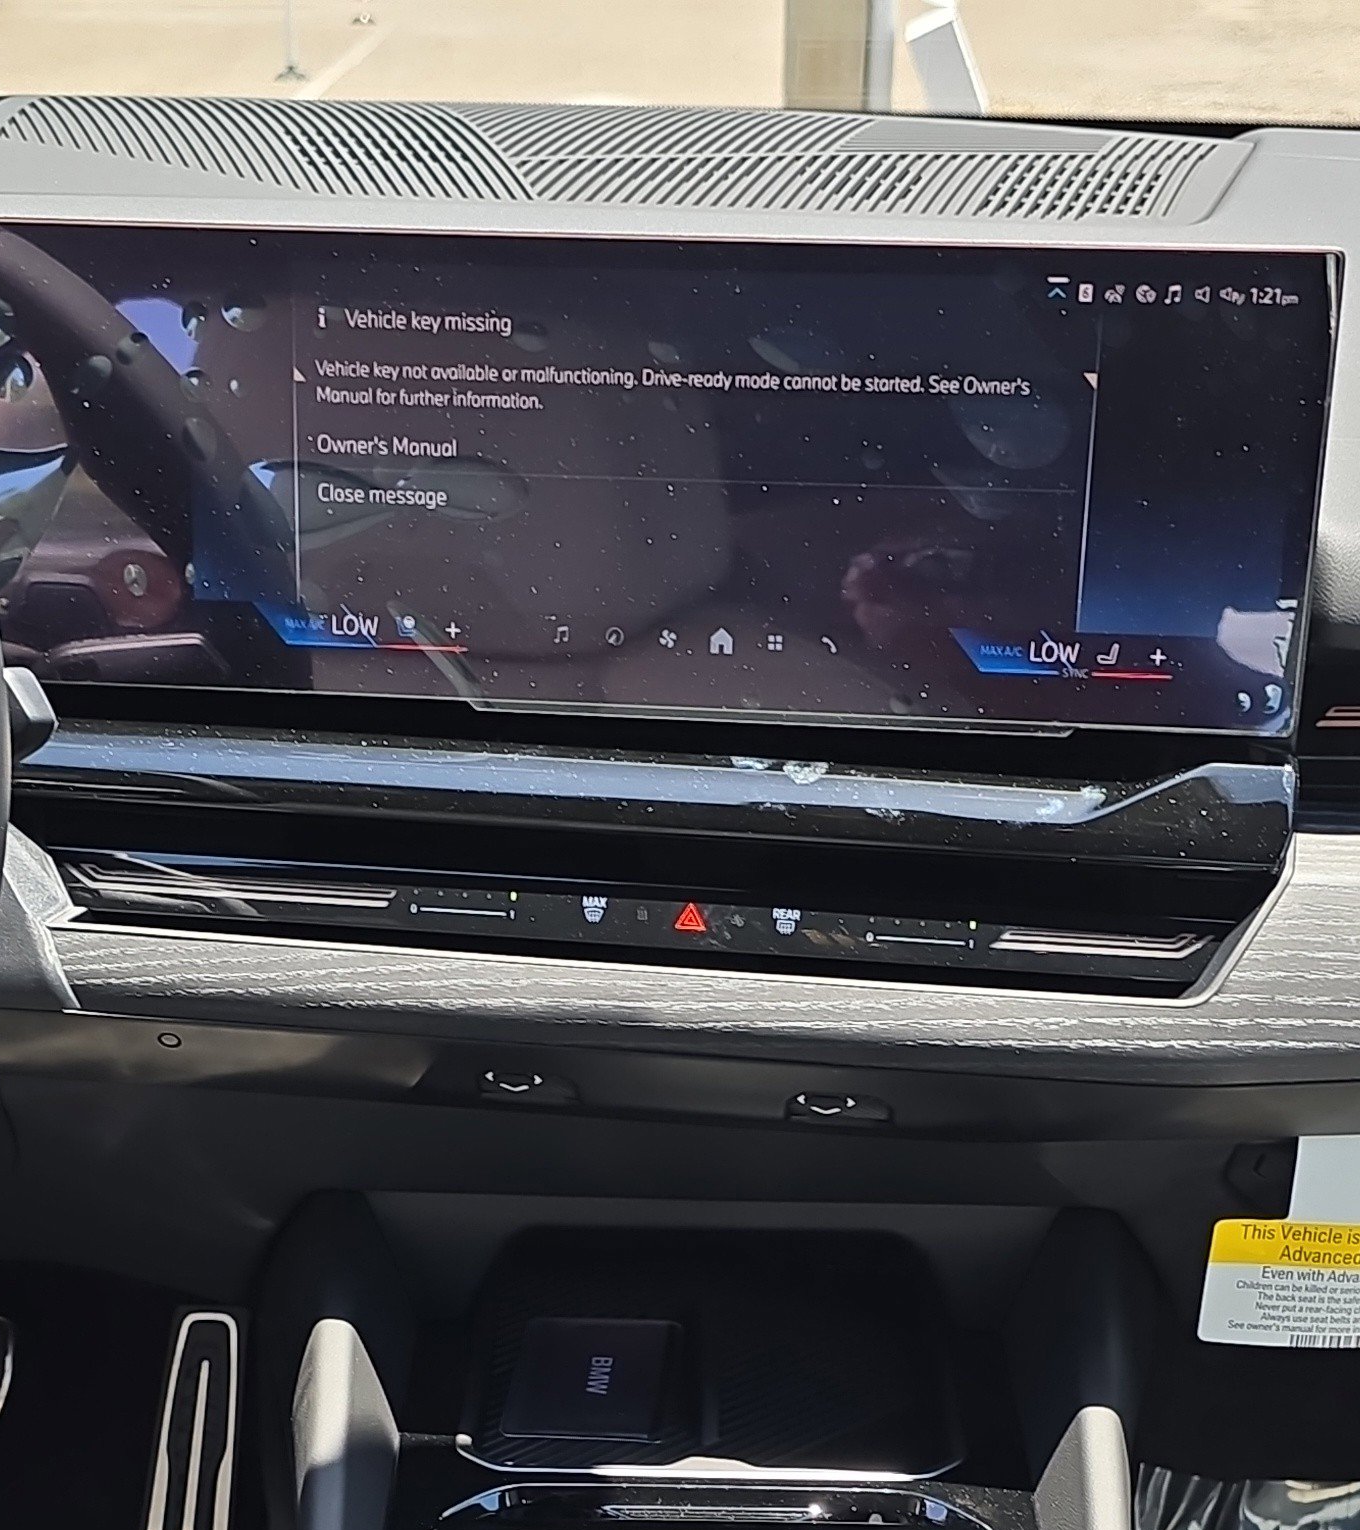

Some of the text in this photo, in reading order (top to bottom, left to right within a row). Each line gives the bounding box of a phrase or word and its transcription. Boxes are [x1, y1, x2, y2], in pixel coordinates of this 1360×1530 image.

[344, 308, 512, 336] Vehicle key missing
[314, 359, 1031, 396] Vehicle key not available or malfunctioning. Drive-ready mode cannot be started. See Owner's
[316, 386, 543, 410] Manual for further information.
[317, 433, 457, 457] Owner's Manual
[317, 483, 448, 510] Close message
[331, 613, 379, 636] LOW
[1029, 640, 1080, 663] LOW
[582, 895, 608, 908] MAX
[772, 907, 801, 921] REAR
[1241, 1224, 1275, 1241] This
[1281, 1225, 1343, 1245] Vehicle
[1348, 1227, 1360, 1245] is
[1262, 1266, 1293, 1280] Even
[1296, 1268, 1324, 1281] with
[1236, 1280, 1273, 1291] Children
[1274, 1283, 1290, 1292] can
[1291, 1283, 1303, 1293] be
[1304, 1284, 1328, 1294] killed
[1329, 1287, 1339, 1295] or
[1258, 1291, 1274, 1301] The
[1276, 1293, 1296, 1303] back
[1298, 1295, 1317, 1304] seat
[1255, 1302, 1281, 1312] Never
[1282, 1303, 1296, 1314] put
[1260, 1312, 1291, 1323] Always
[1293, 1315, 1309, 1323] use
[1228, 1319, 1245, 1330] See
[1246, 1322, 1281, 1331] owner's
[1282, 1324, 1314, 1333] manual
[586, 1357, 613, 1394] BMW
